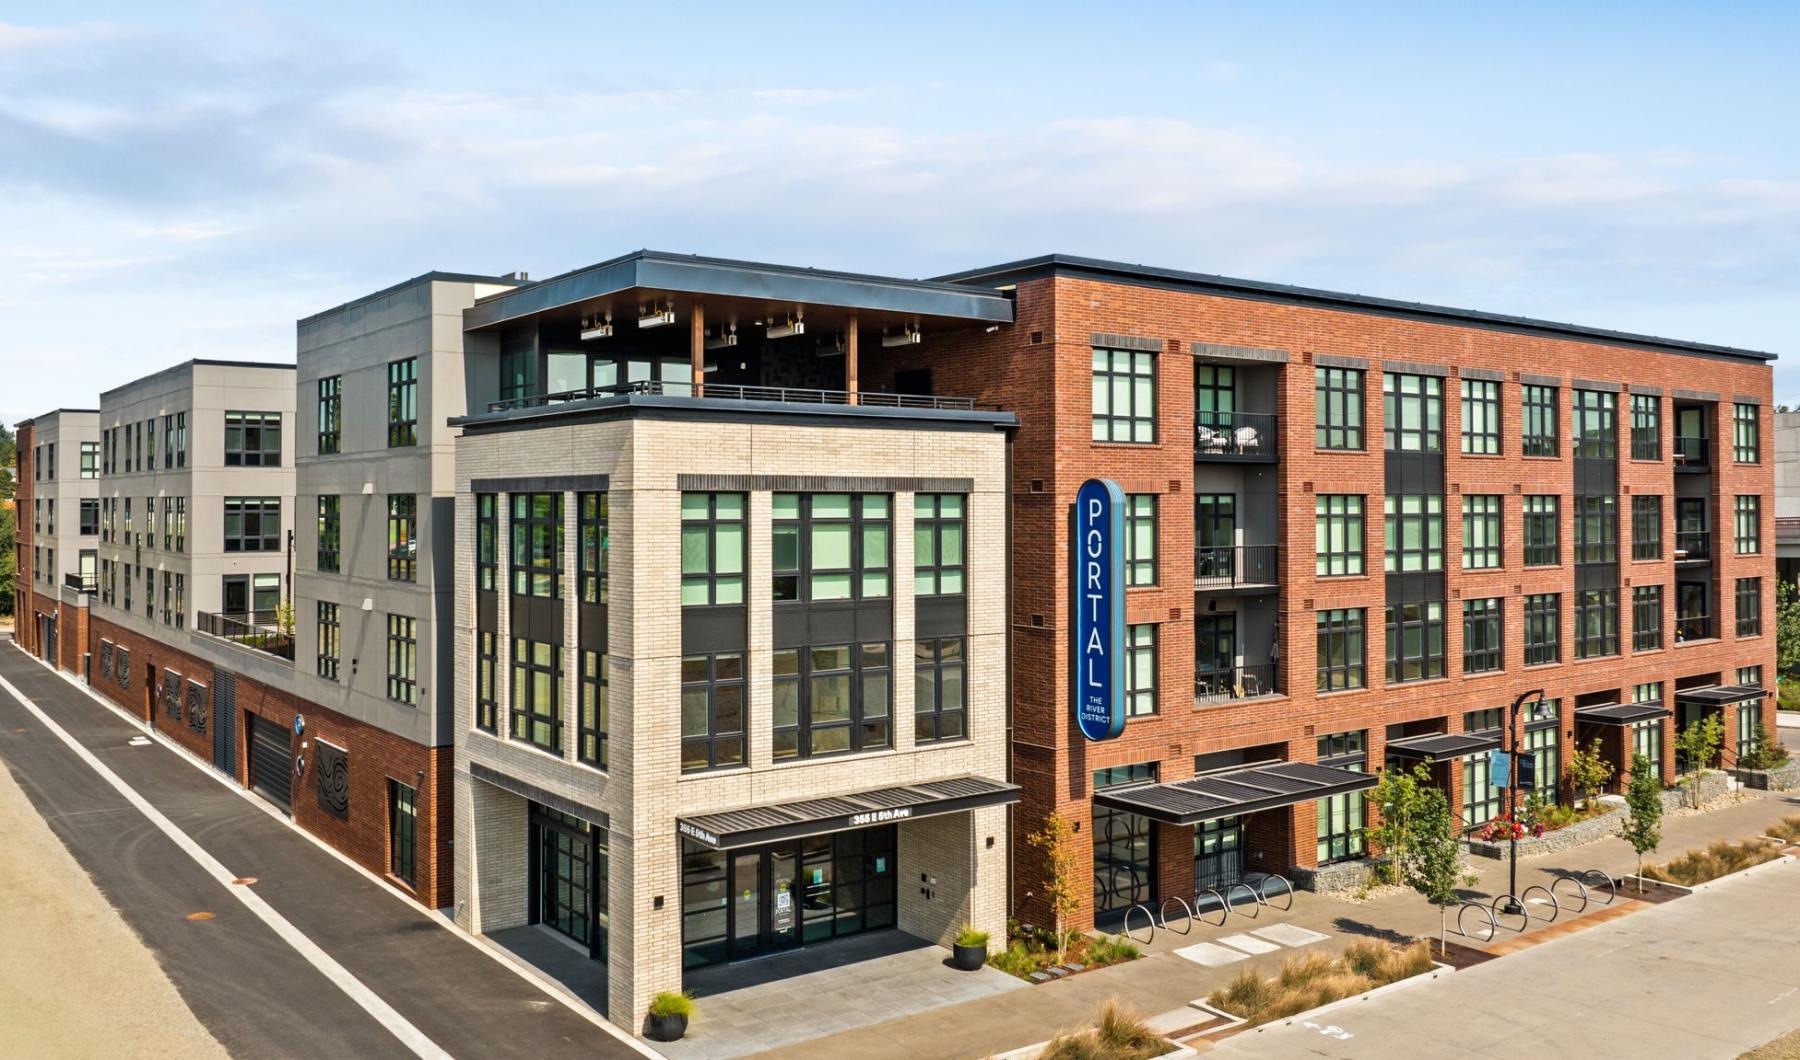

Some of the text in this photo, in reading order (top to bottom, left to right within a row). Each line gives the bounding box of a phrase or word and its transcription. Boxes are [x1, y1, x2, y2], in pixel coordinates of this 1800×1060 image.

[1087, 498, 1103, 687] PORTAL
[1089, 696, 1102, 705] THE
[1086, 704, 1105, 714] RIVER
[1081, 712, 1110, 724] DISTRICT
[871, 812, 877, 822] E
[893, 808, 909, 818] Ave
[690, 826, 696, 836] E
